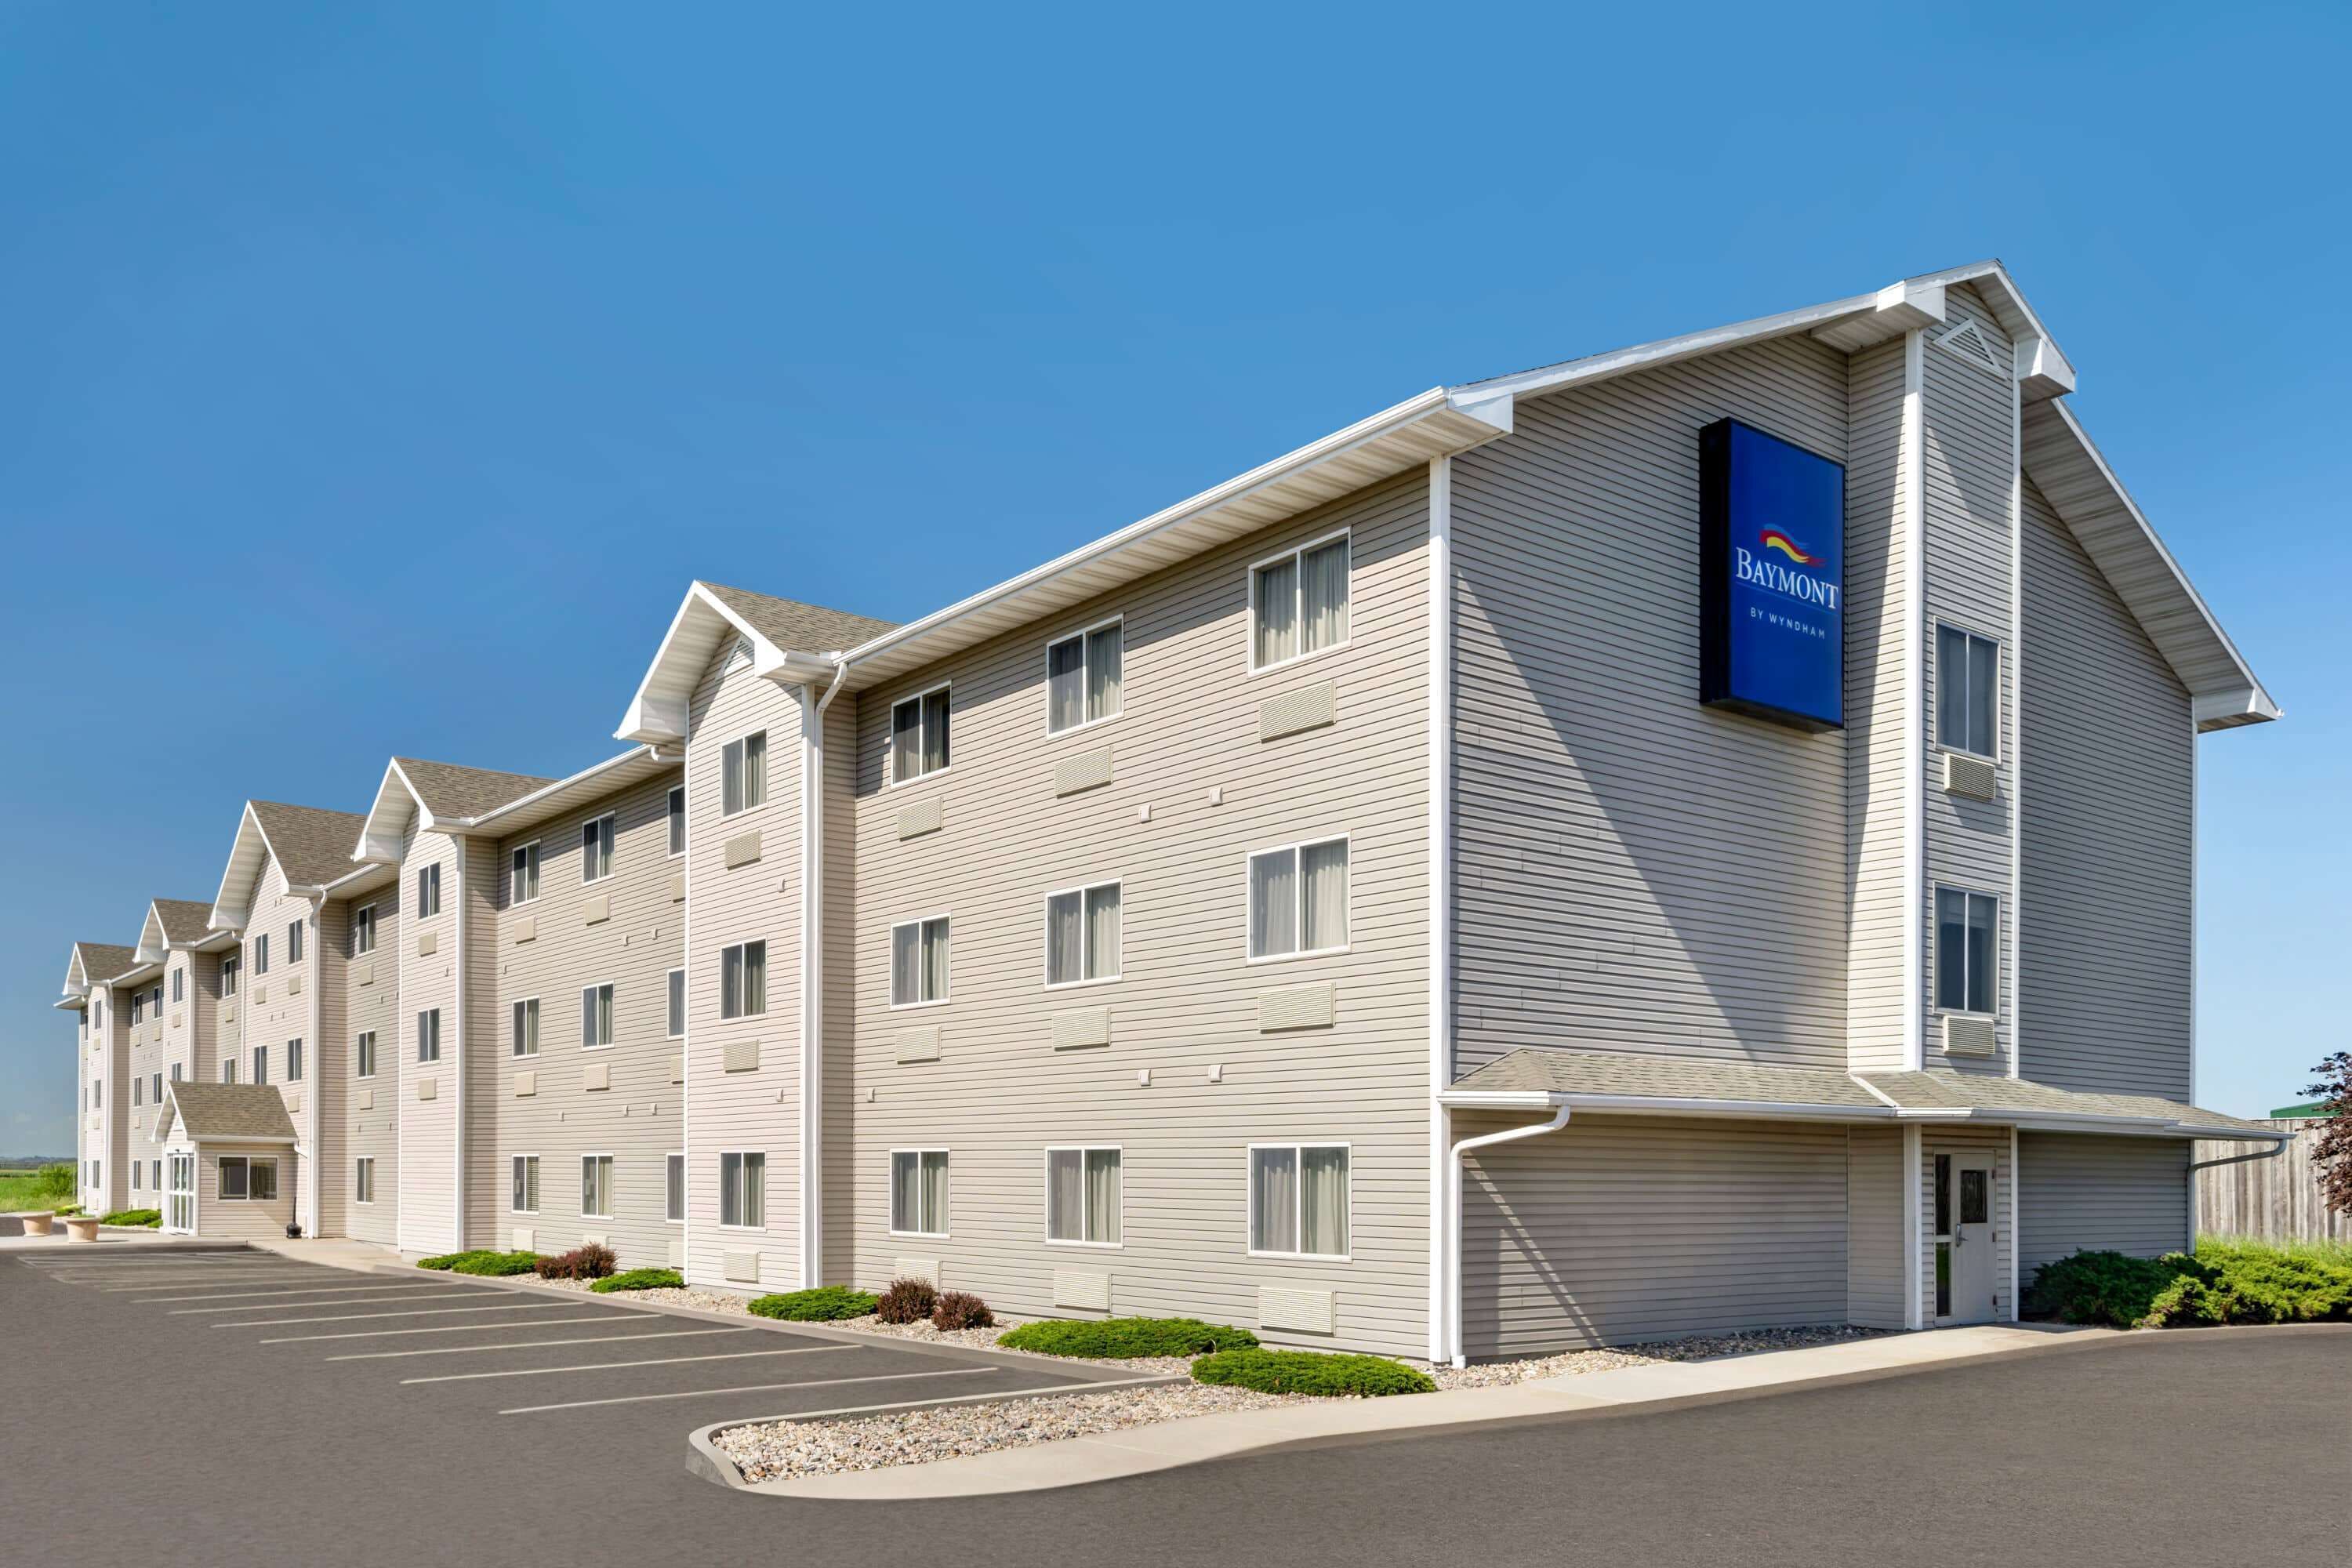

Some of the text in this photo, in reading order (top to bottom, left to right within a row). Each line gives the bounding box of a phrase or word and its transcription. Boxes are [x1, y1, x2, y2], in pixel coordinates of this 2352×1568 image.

[1736, 546, 1838, 609] BAYMONT
[1750, 607, 1825, 640] BY WYNDHAM
